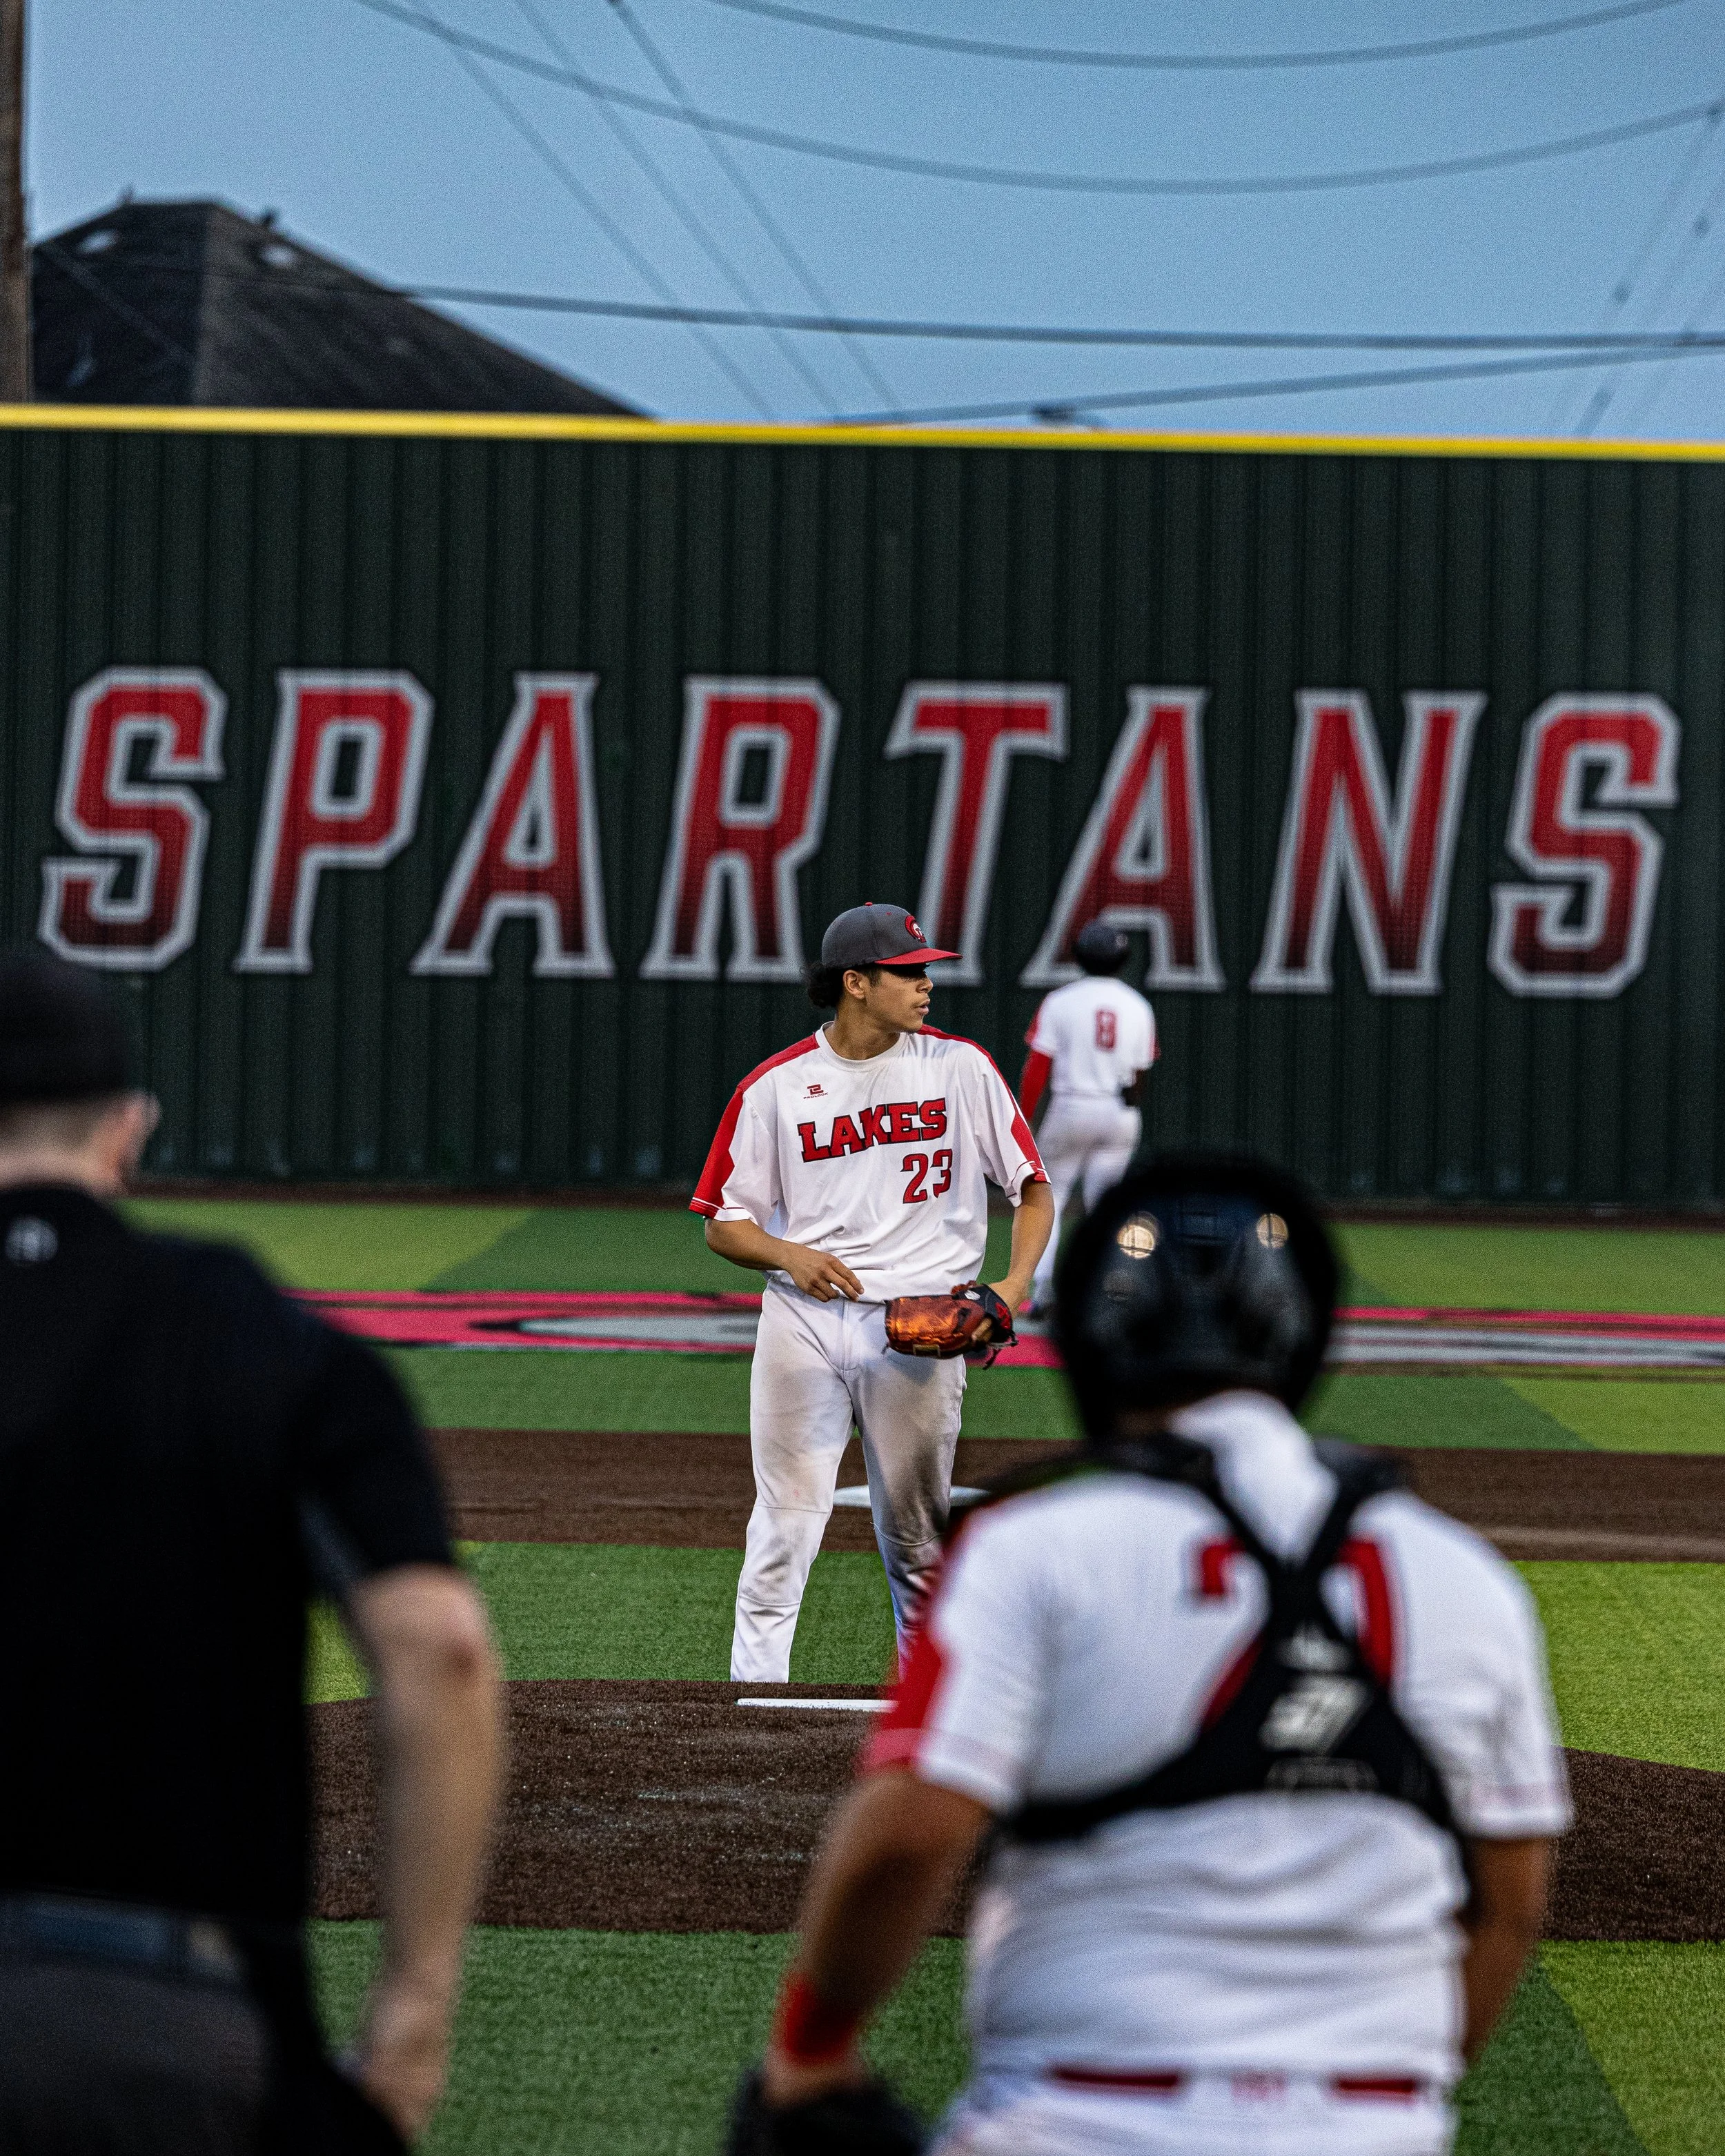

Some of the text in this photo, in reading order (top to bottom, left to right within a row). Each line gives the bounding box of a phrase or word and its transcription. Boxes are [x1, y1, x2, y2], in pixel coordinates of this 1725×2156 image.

[37, 665, 1682, 996] SPARTANS
[797, 1097, 947, 1163] LAKES
[900, 1148, 953, 1204] 23
